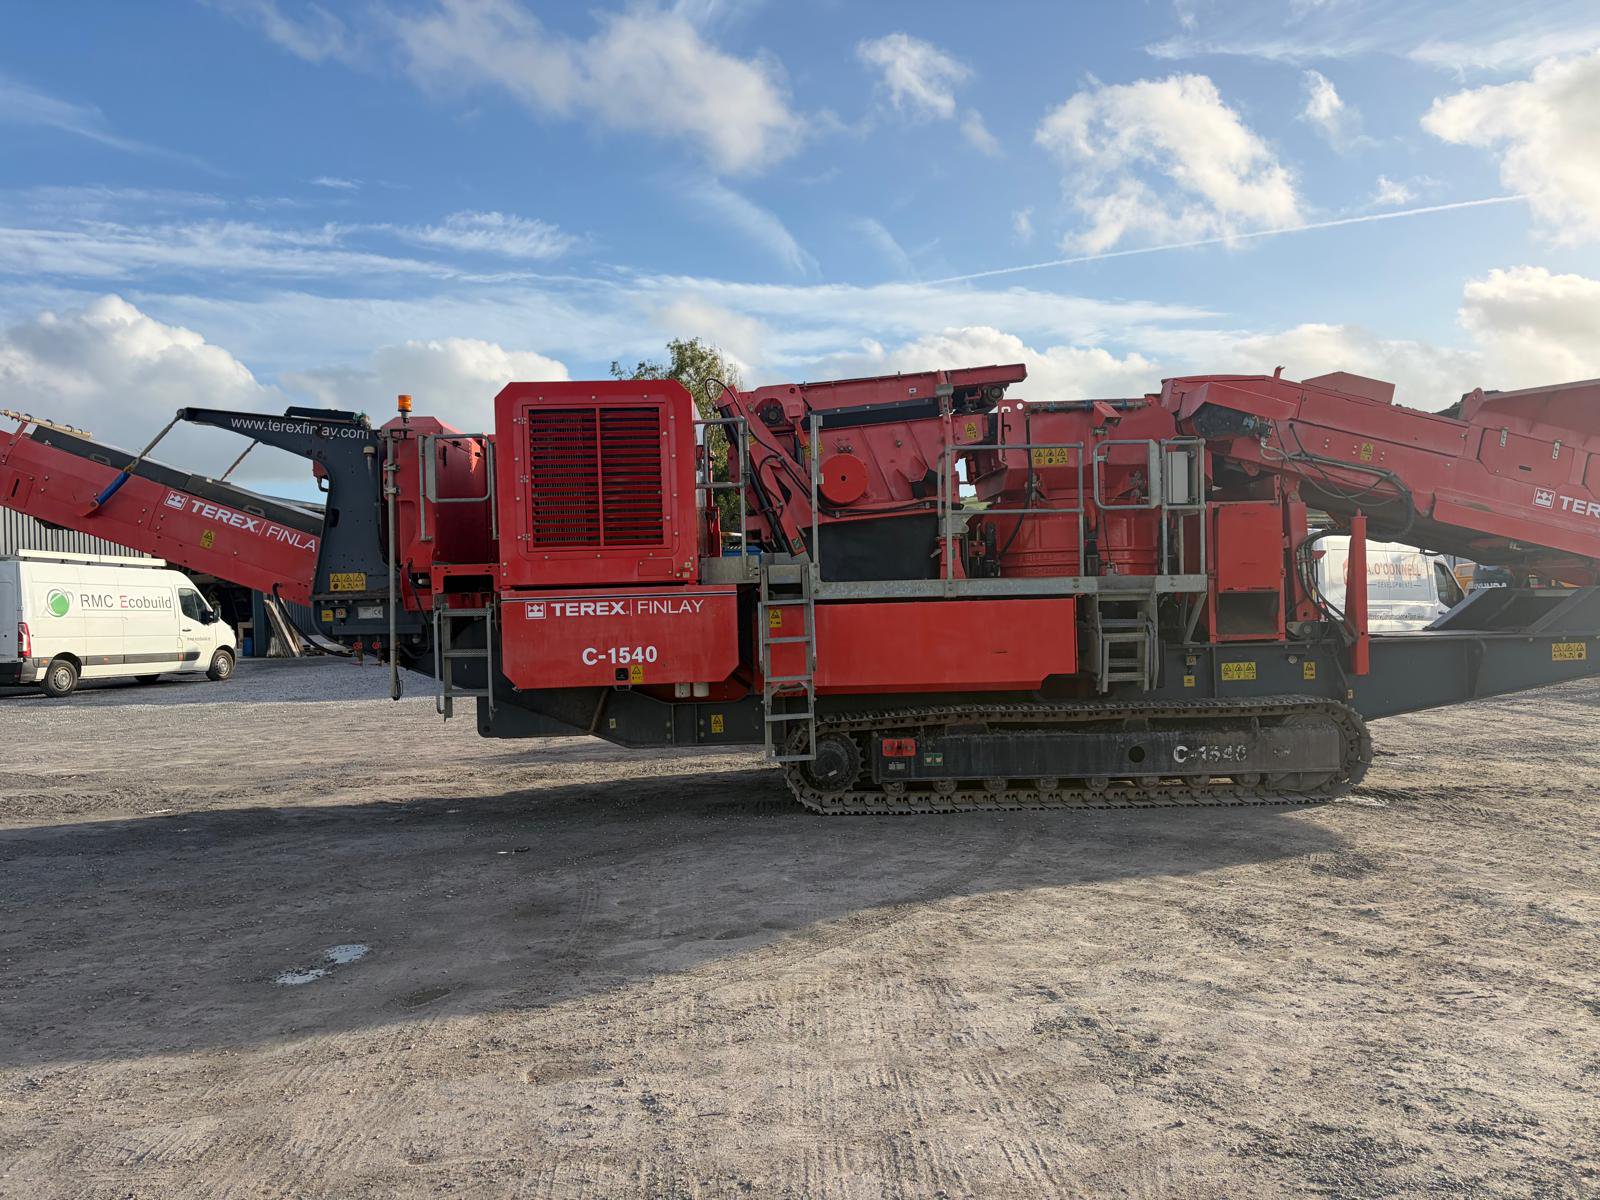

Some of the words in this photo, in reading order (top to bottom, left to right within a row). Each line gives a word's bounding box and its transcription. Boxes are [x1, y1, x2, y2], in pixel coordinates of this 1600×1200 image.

[231, 418, 369, 440] www.terexfinay.com
[191, 499, 258, 533] TEREX
[80, 594, 114, 608] RMC
[120, 595, 172, 609] Ecobuild
[551, 601, 629, 617] TEREX
[637, 599, 704, 614] FINLAY
[582, 645, 658, 666] C-1540
[1173, 745, 1247, 763] C-1540
